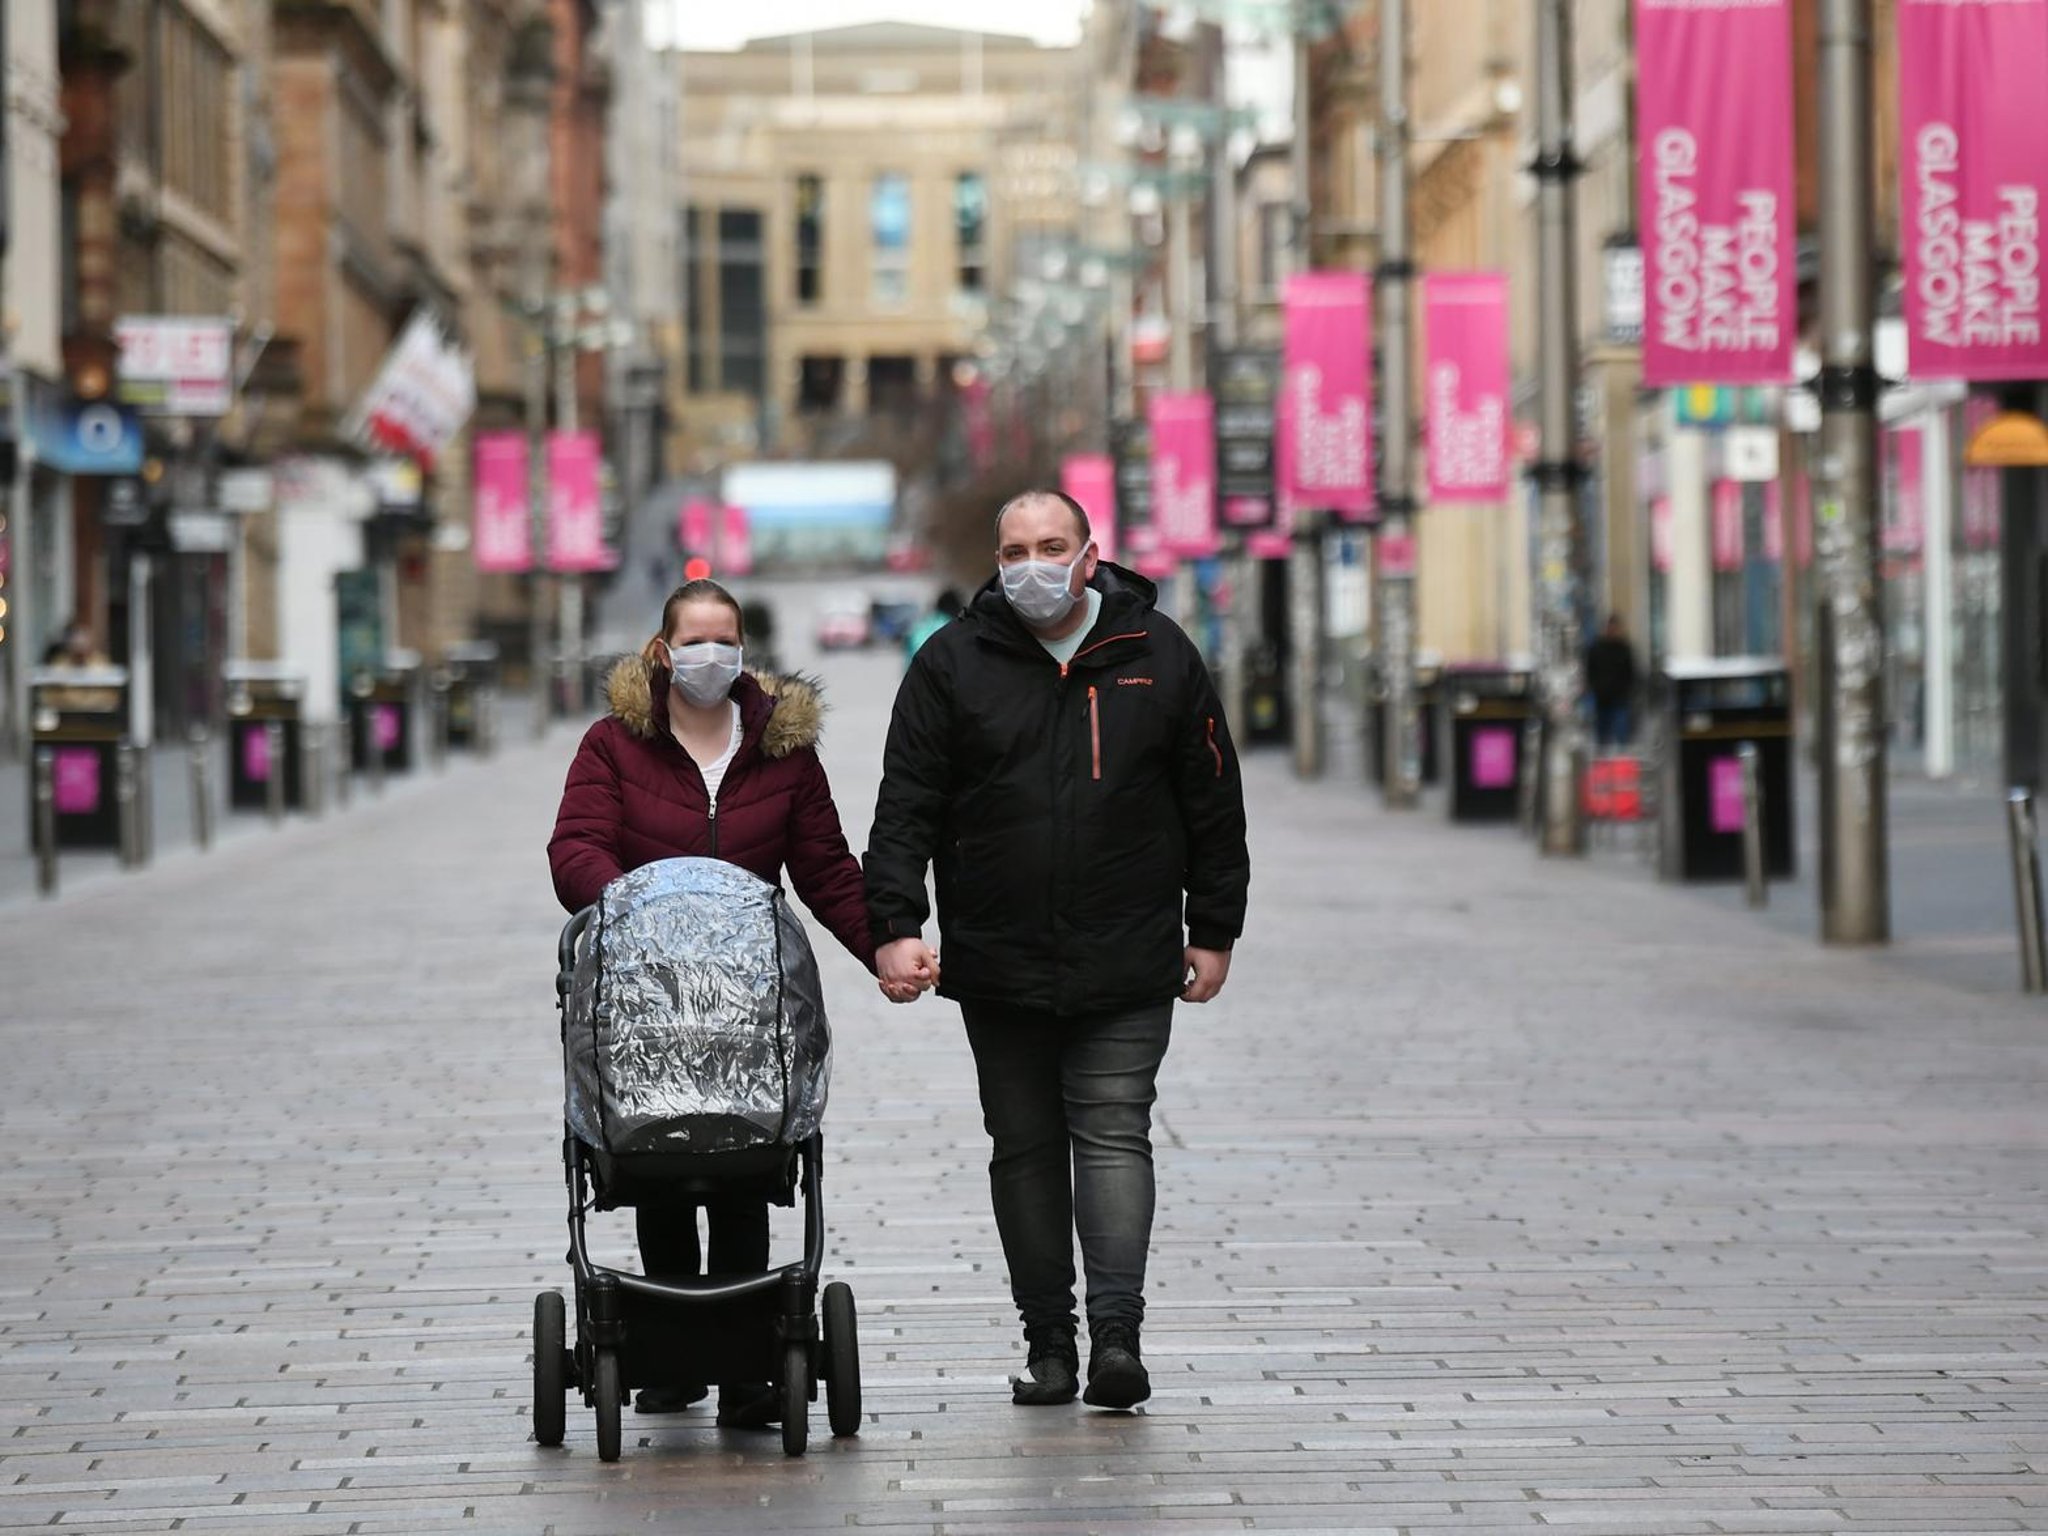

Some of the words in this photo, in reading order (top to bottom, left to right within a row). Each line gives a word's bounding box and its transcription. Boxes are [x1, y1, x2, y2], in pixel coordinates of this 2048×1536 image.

[1654, 128, 1698, 351] GLASGOW
[1701, 224, 1738, 351] MAKE
[1737, 189, 1778, 351] PEOPLE
[1916, 122, 1960, 347] GLASGOW
[1962, 219, 1999, 347] MAKE
[1998, 184, 2040, 346] PEOPLE
